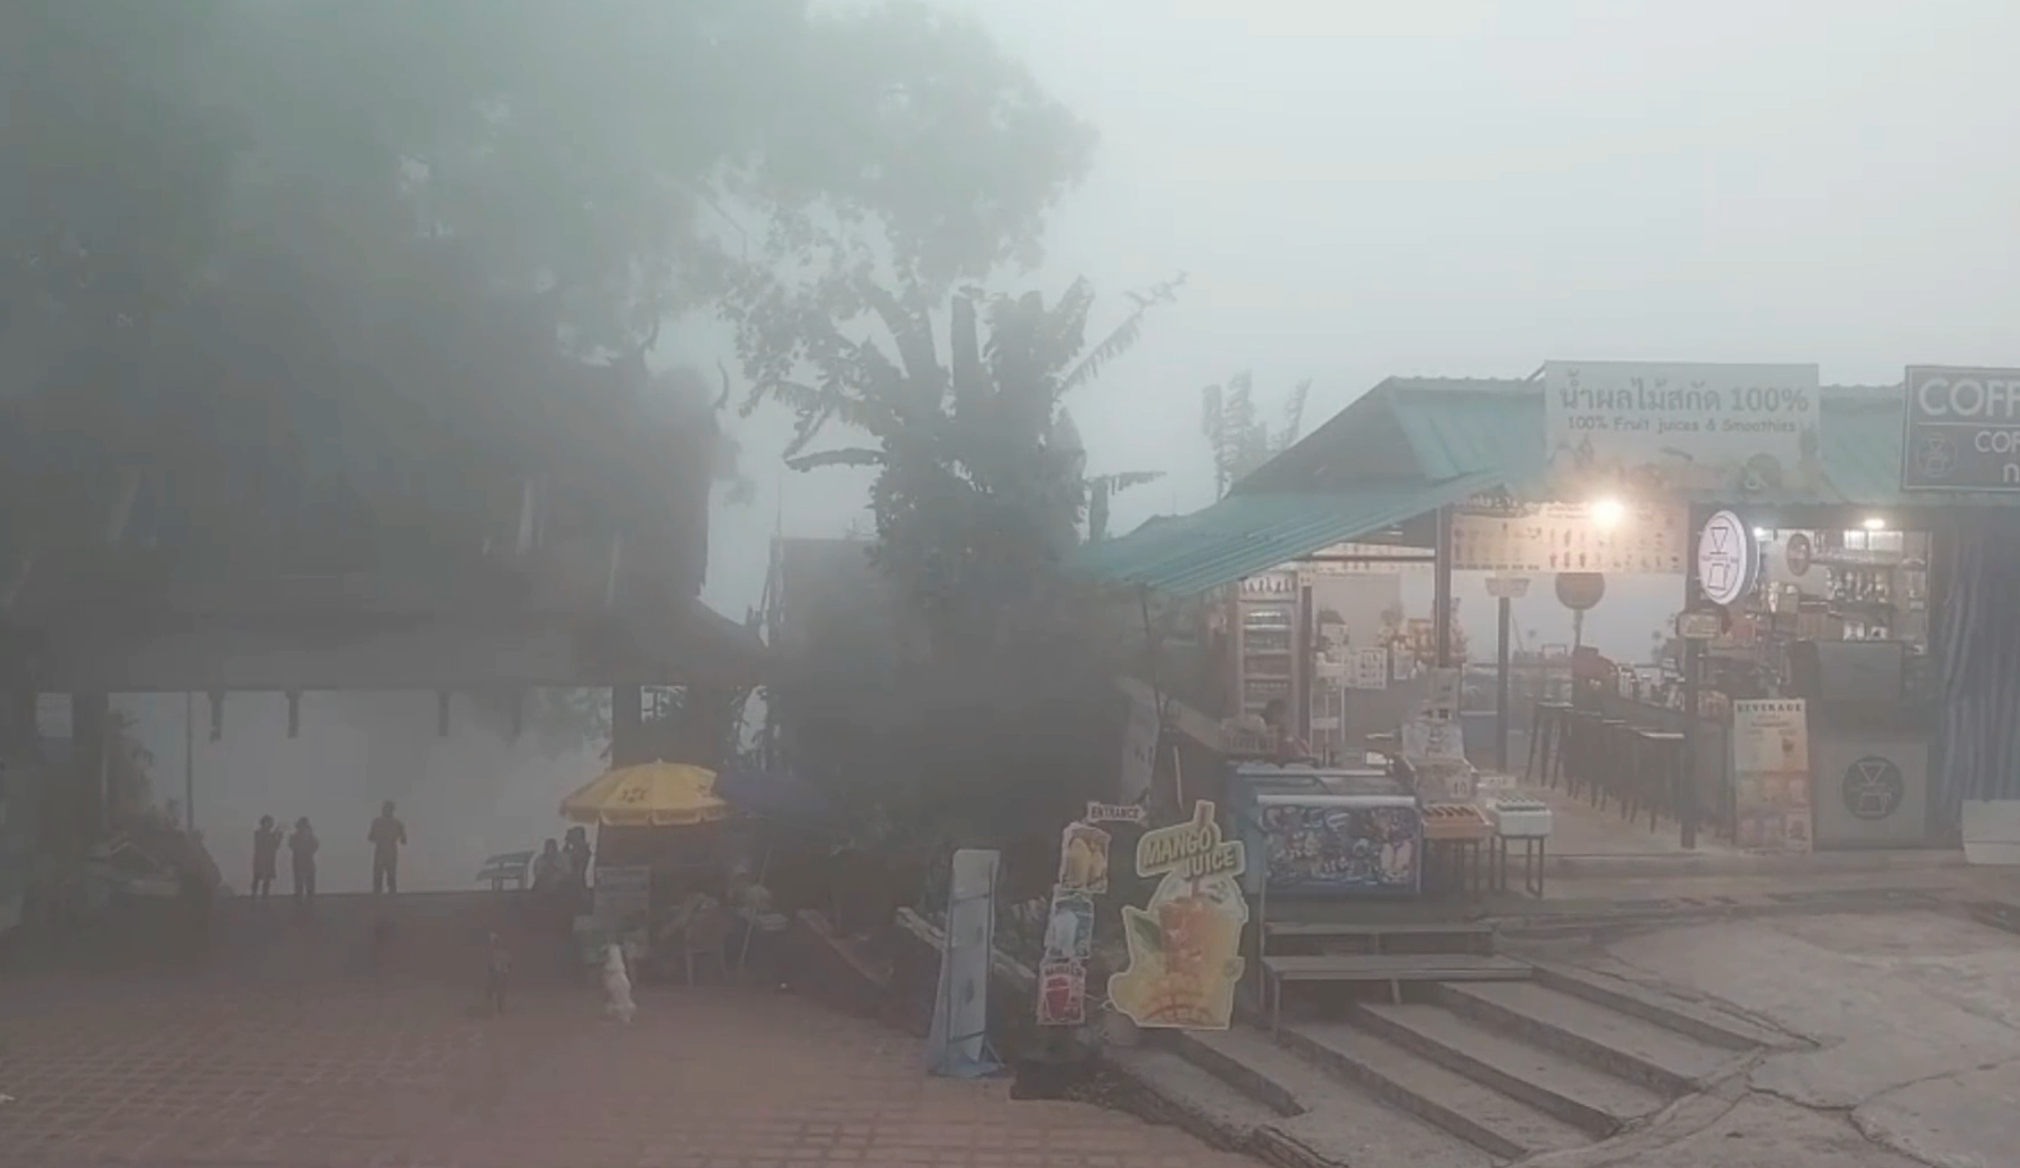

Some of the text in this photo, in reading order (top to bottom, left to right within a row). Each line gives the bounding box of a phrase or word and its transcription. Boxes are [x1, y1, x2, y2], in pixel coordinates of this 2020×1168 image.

[1730, 387, 1809, 412] 100%
[1567, 415, 1609, 430] 100%
[1614, 415, 1650, 431] Fruit
[1706, 417, 1716, 432] &
[1722, 417, 1797, 433] Smoothies
[1091, 806, 1140, 819] ENTRANCE
[1143, 827, 1212, 869] MANGO
[1182, 846, 1237, 881] JUICE
